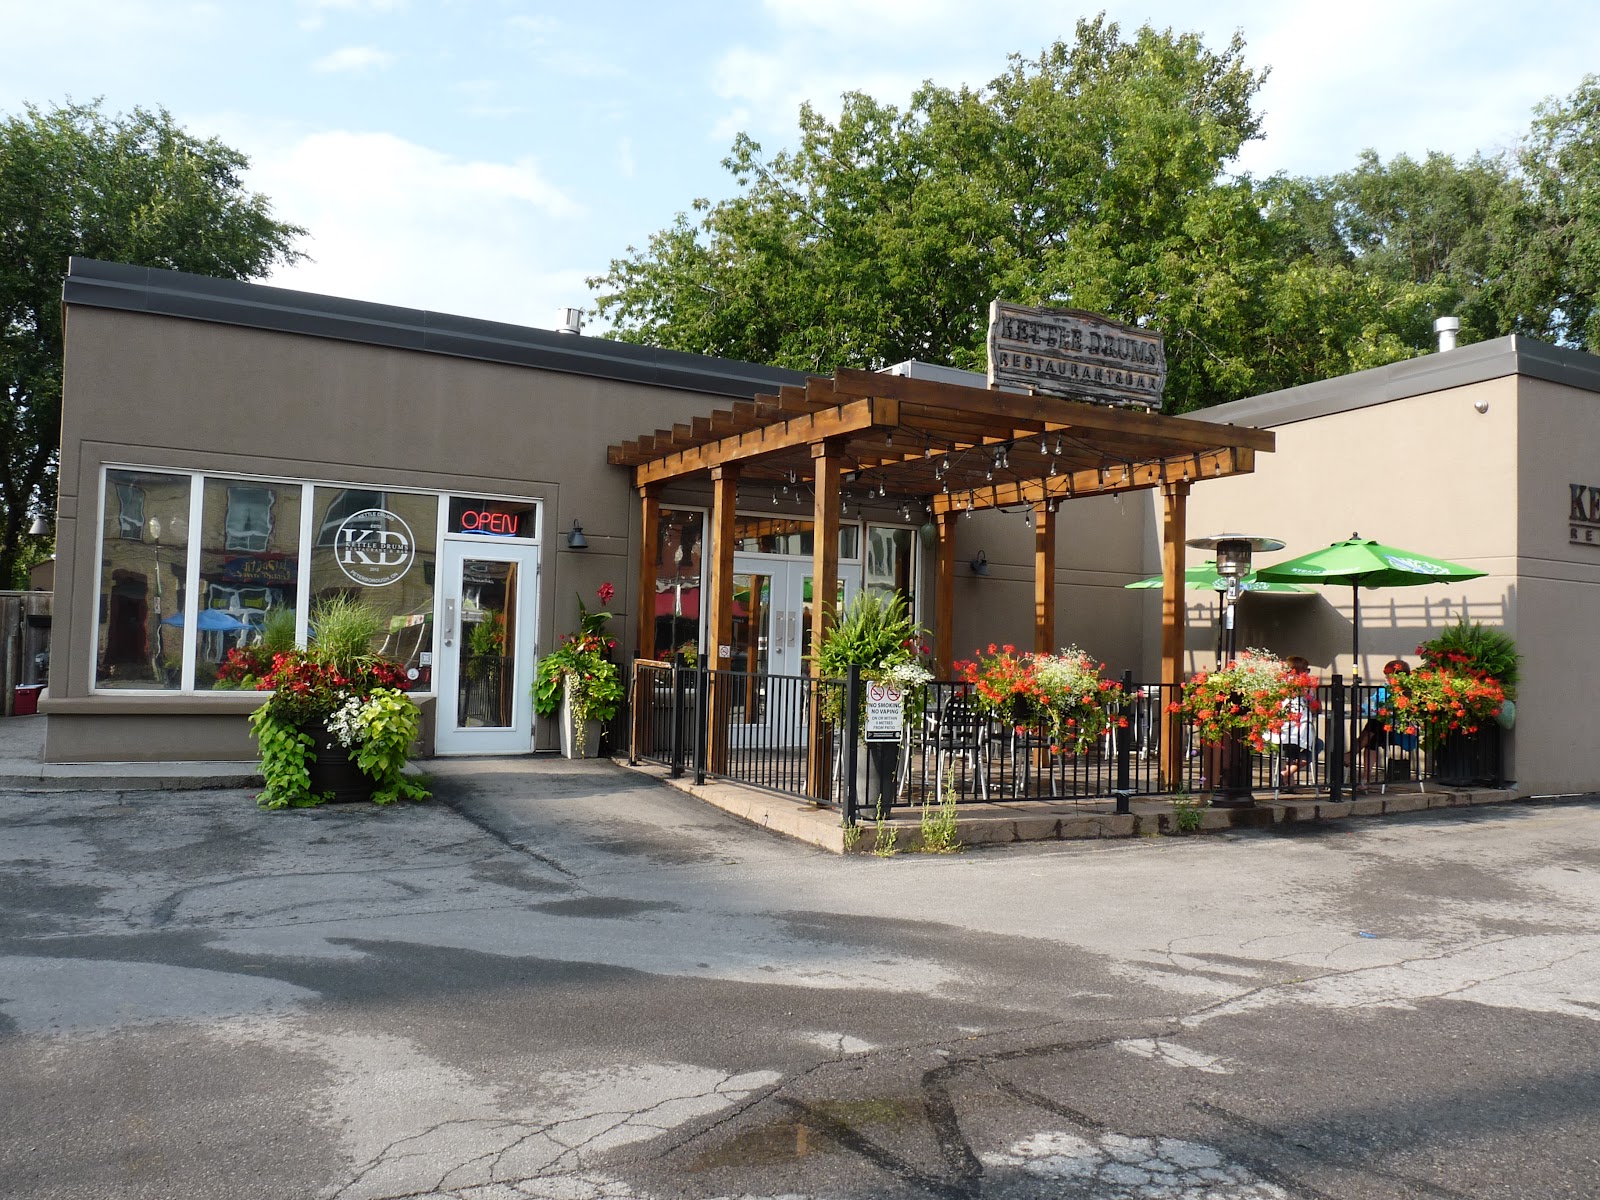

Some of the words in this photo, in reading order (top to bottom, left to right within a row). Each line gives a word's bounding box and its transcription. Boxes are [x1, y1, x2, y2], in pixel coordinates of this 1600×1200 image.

[1001, 315, 1083, 352] KETTLE
[1087, 331, 1157, 366] DRUMS
[461, 510, 518, 533] OPEN
[341, 528, 409, 566] KD
